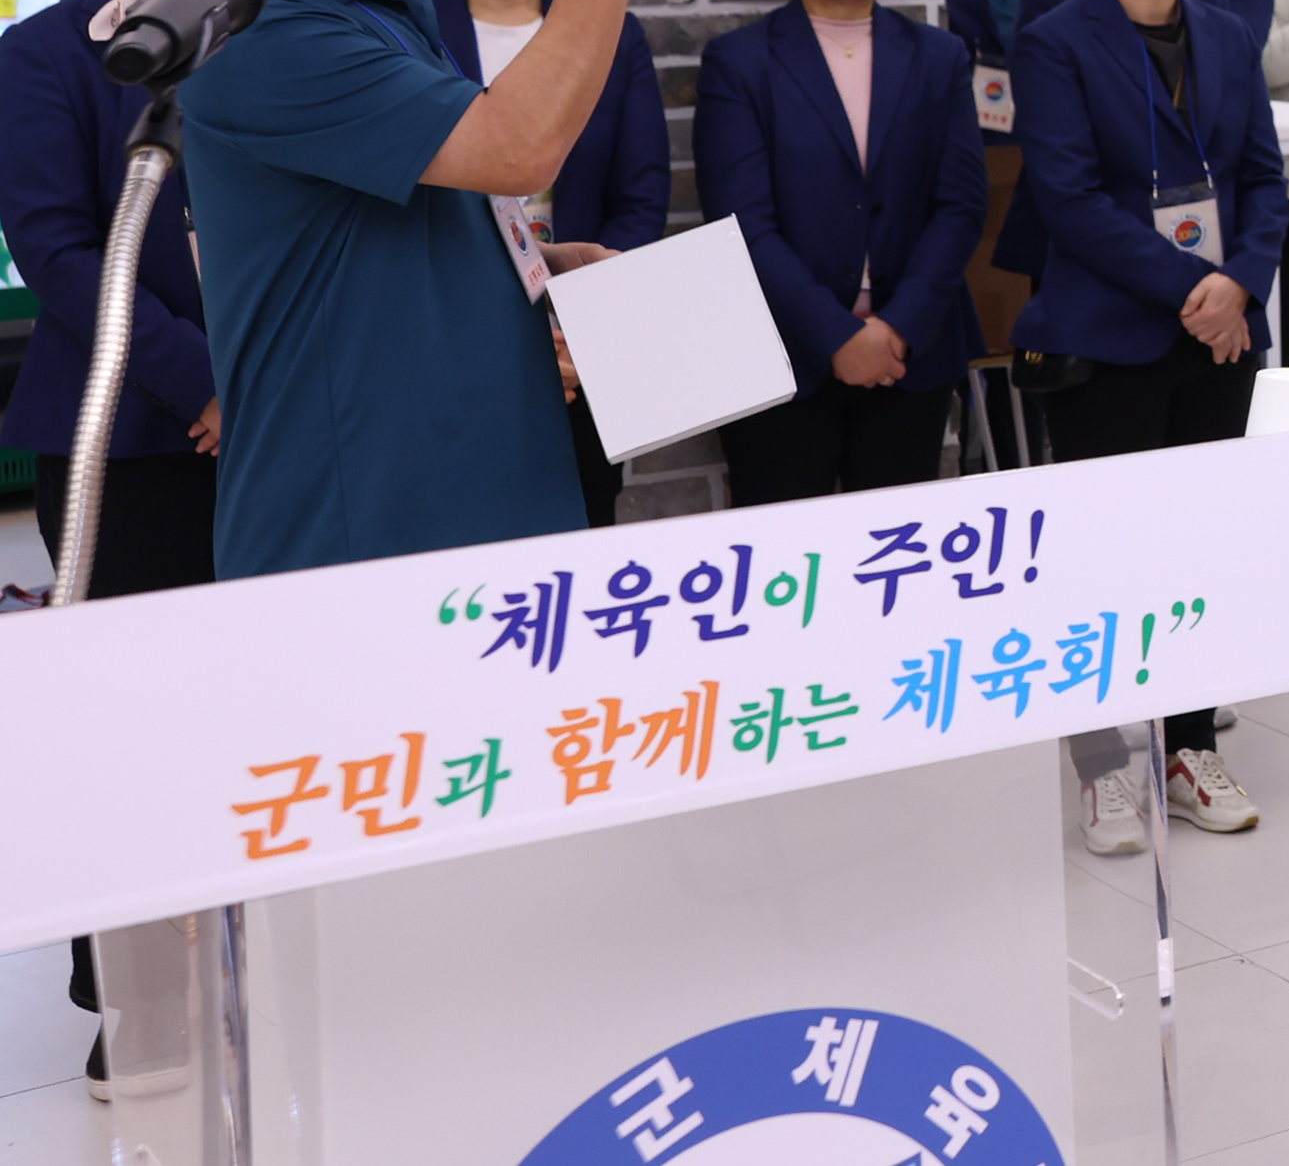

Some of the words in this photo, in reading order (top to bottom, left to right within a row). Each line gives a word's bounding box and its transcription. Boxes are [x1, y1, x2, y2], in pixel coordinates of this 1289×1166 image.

[438, 544, 821, 673] “체육인이
[852, 507, 1046, 616] 주인!
[231, 731, 512, 861] 군민과
[546, 679, 860, 805] 함께하는
[882, 597, 1206, 734] 체육회!”
[609, 1016, 1046, 1166] 군체육
